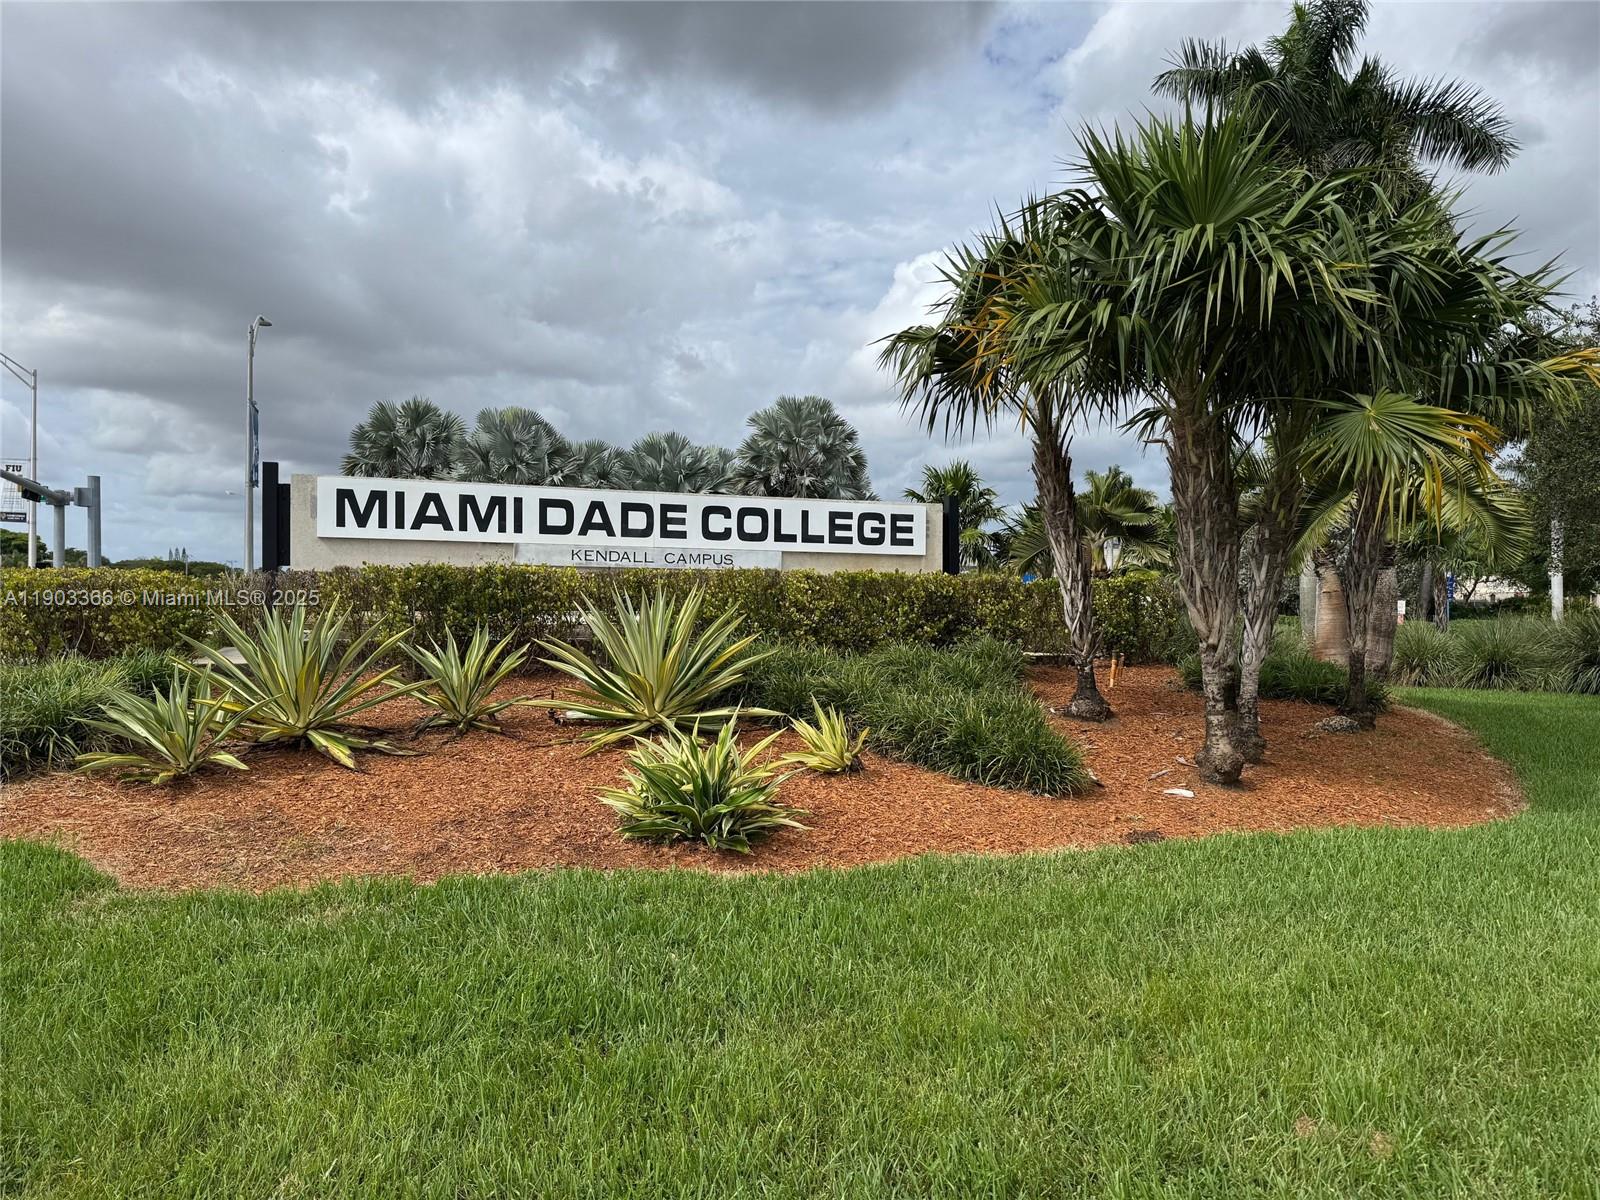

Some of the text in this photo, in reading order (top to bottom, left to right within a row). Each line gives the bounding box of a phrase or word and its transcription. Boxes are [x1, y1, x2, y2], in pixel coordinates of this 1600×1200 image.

[5, 464, 22, 472] FIU
[336, 488, 914, 546] MIAMI DADE COLLEGE
[571, 549, 734, 566] KENDALL CAMPUS
